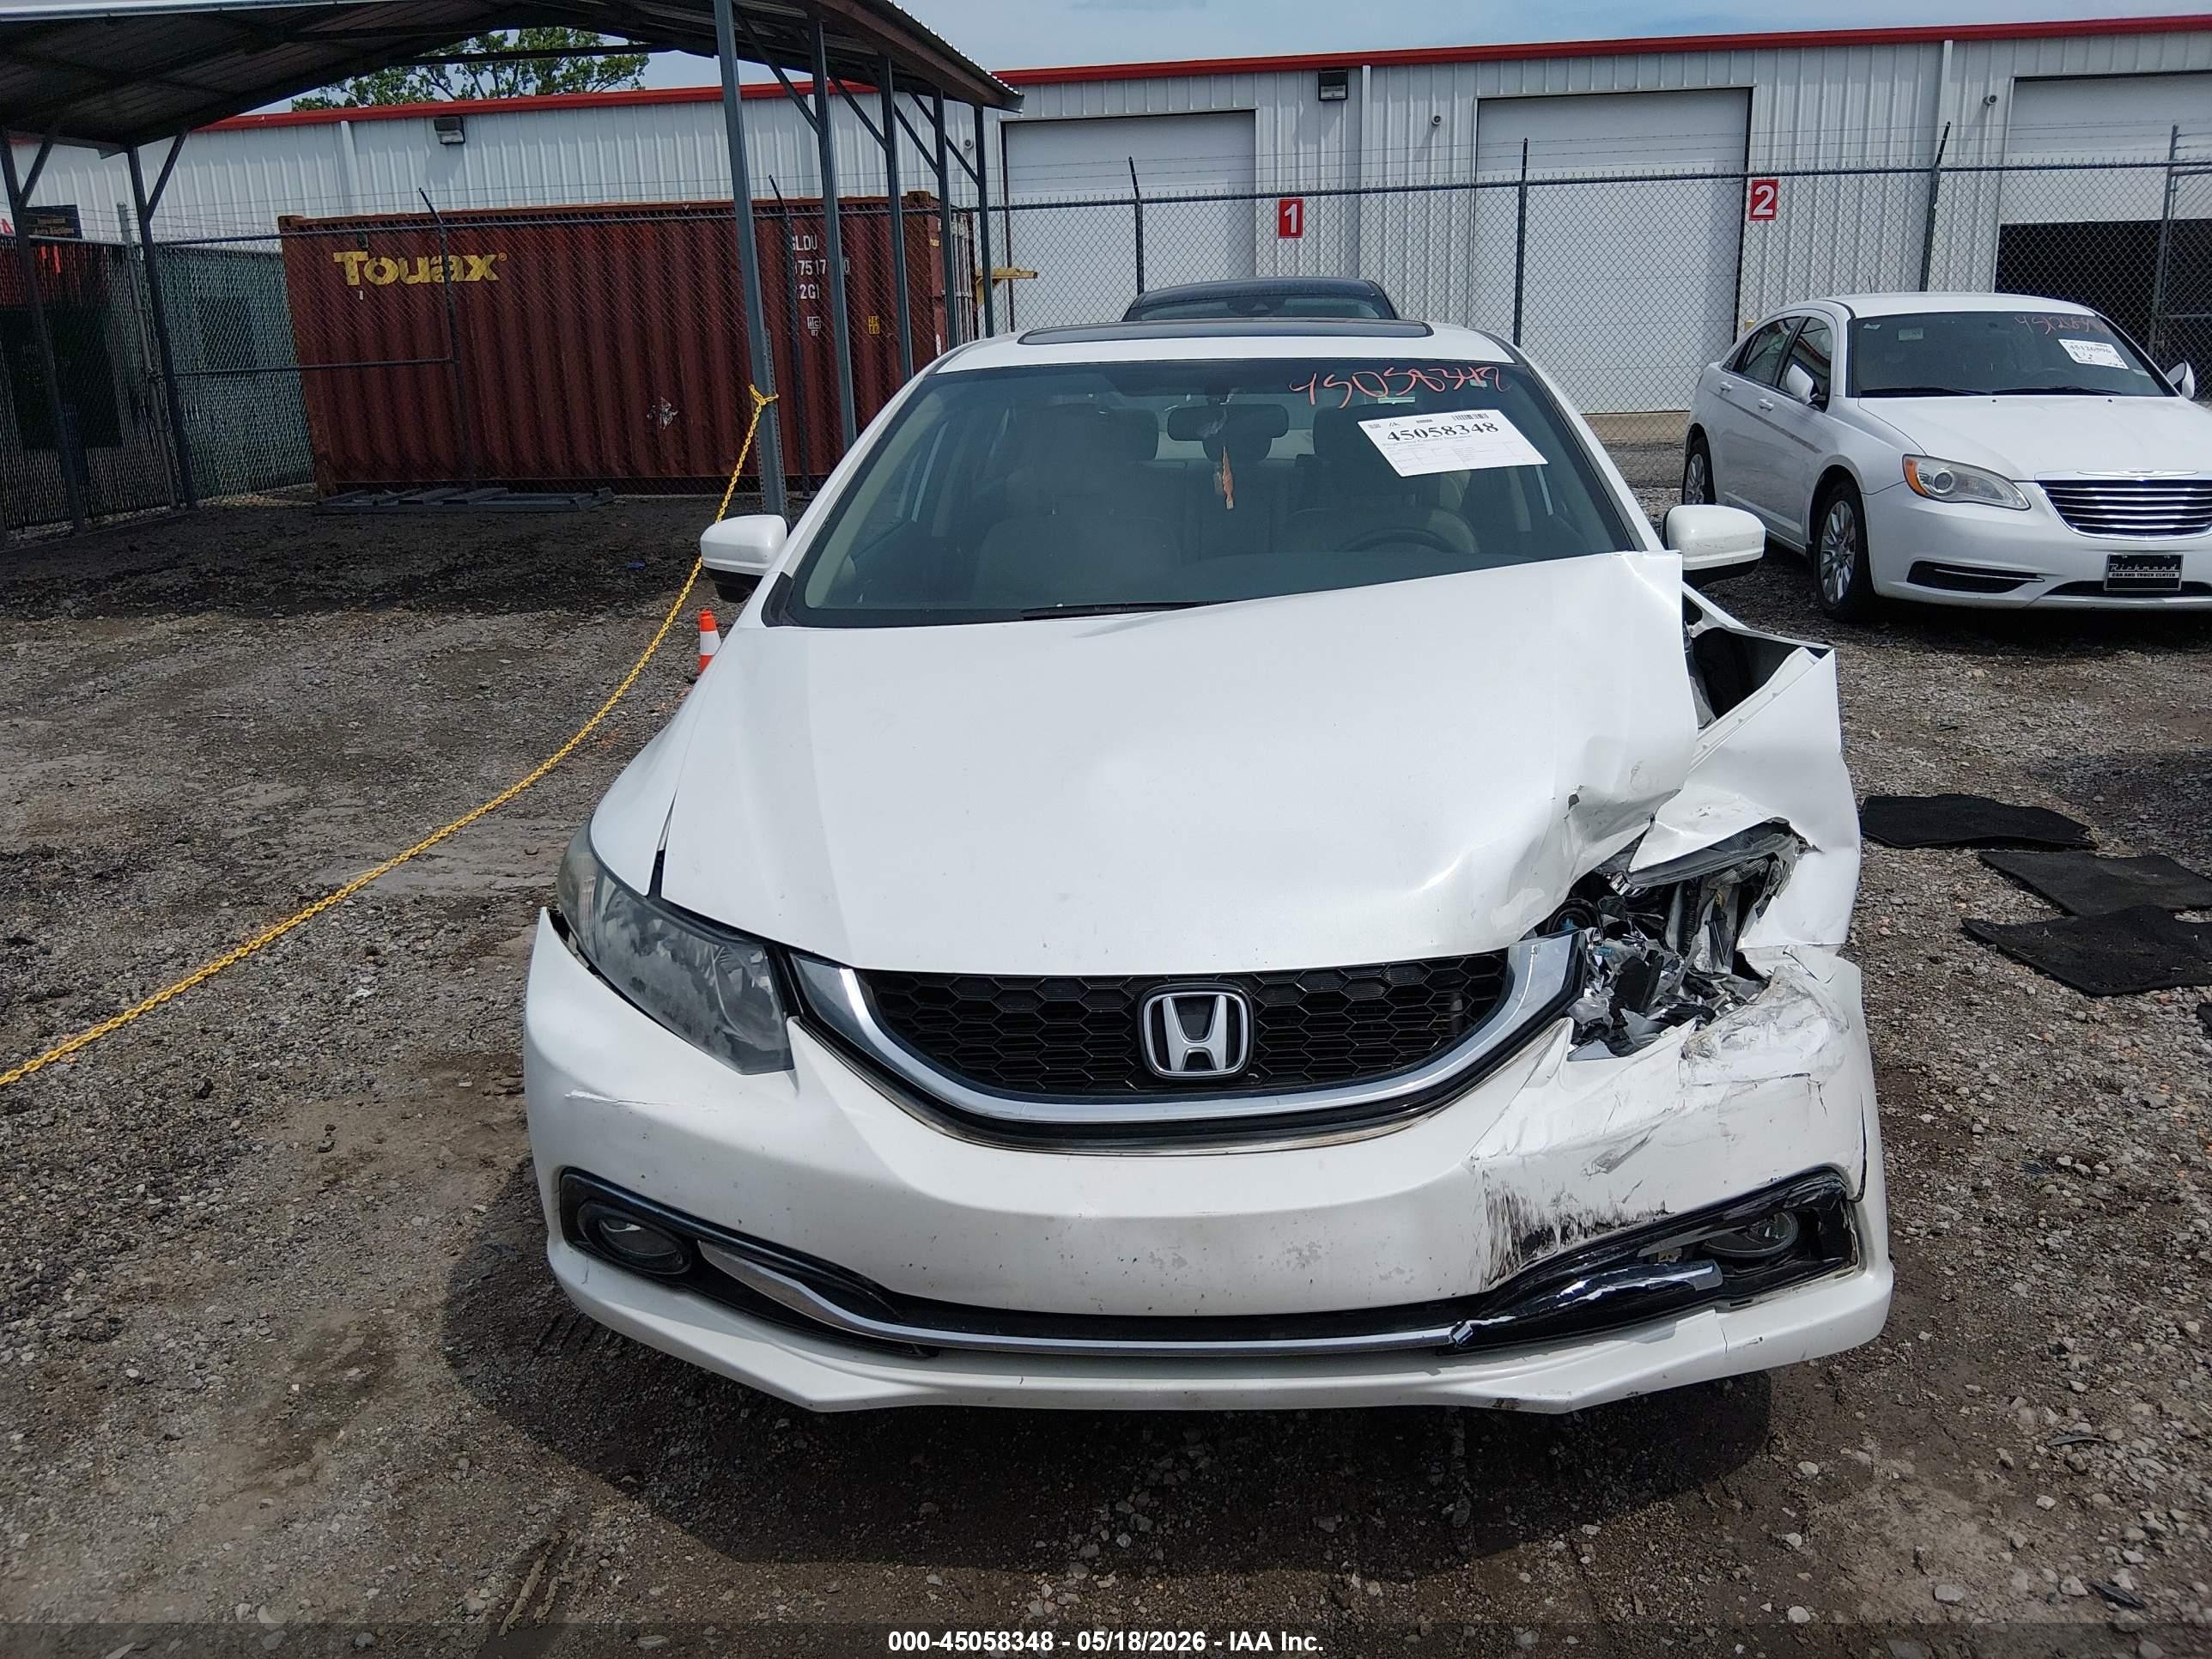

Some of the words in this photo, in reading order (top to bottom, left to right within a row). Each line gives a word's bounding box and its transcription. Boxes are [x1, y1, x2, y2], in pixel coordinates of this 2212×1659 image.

[1753, 185, 1775, 216] 2
[1284, 204, 1297, 234] 1
[794, 258, 827, 276] 7517
[795, 283, 820, 300] 2G1
[1387, 422, 1499, 442] 45058348
[2108, 563, 2180, 572] Richmond
